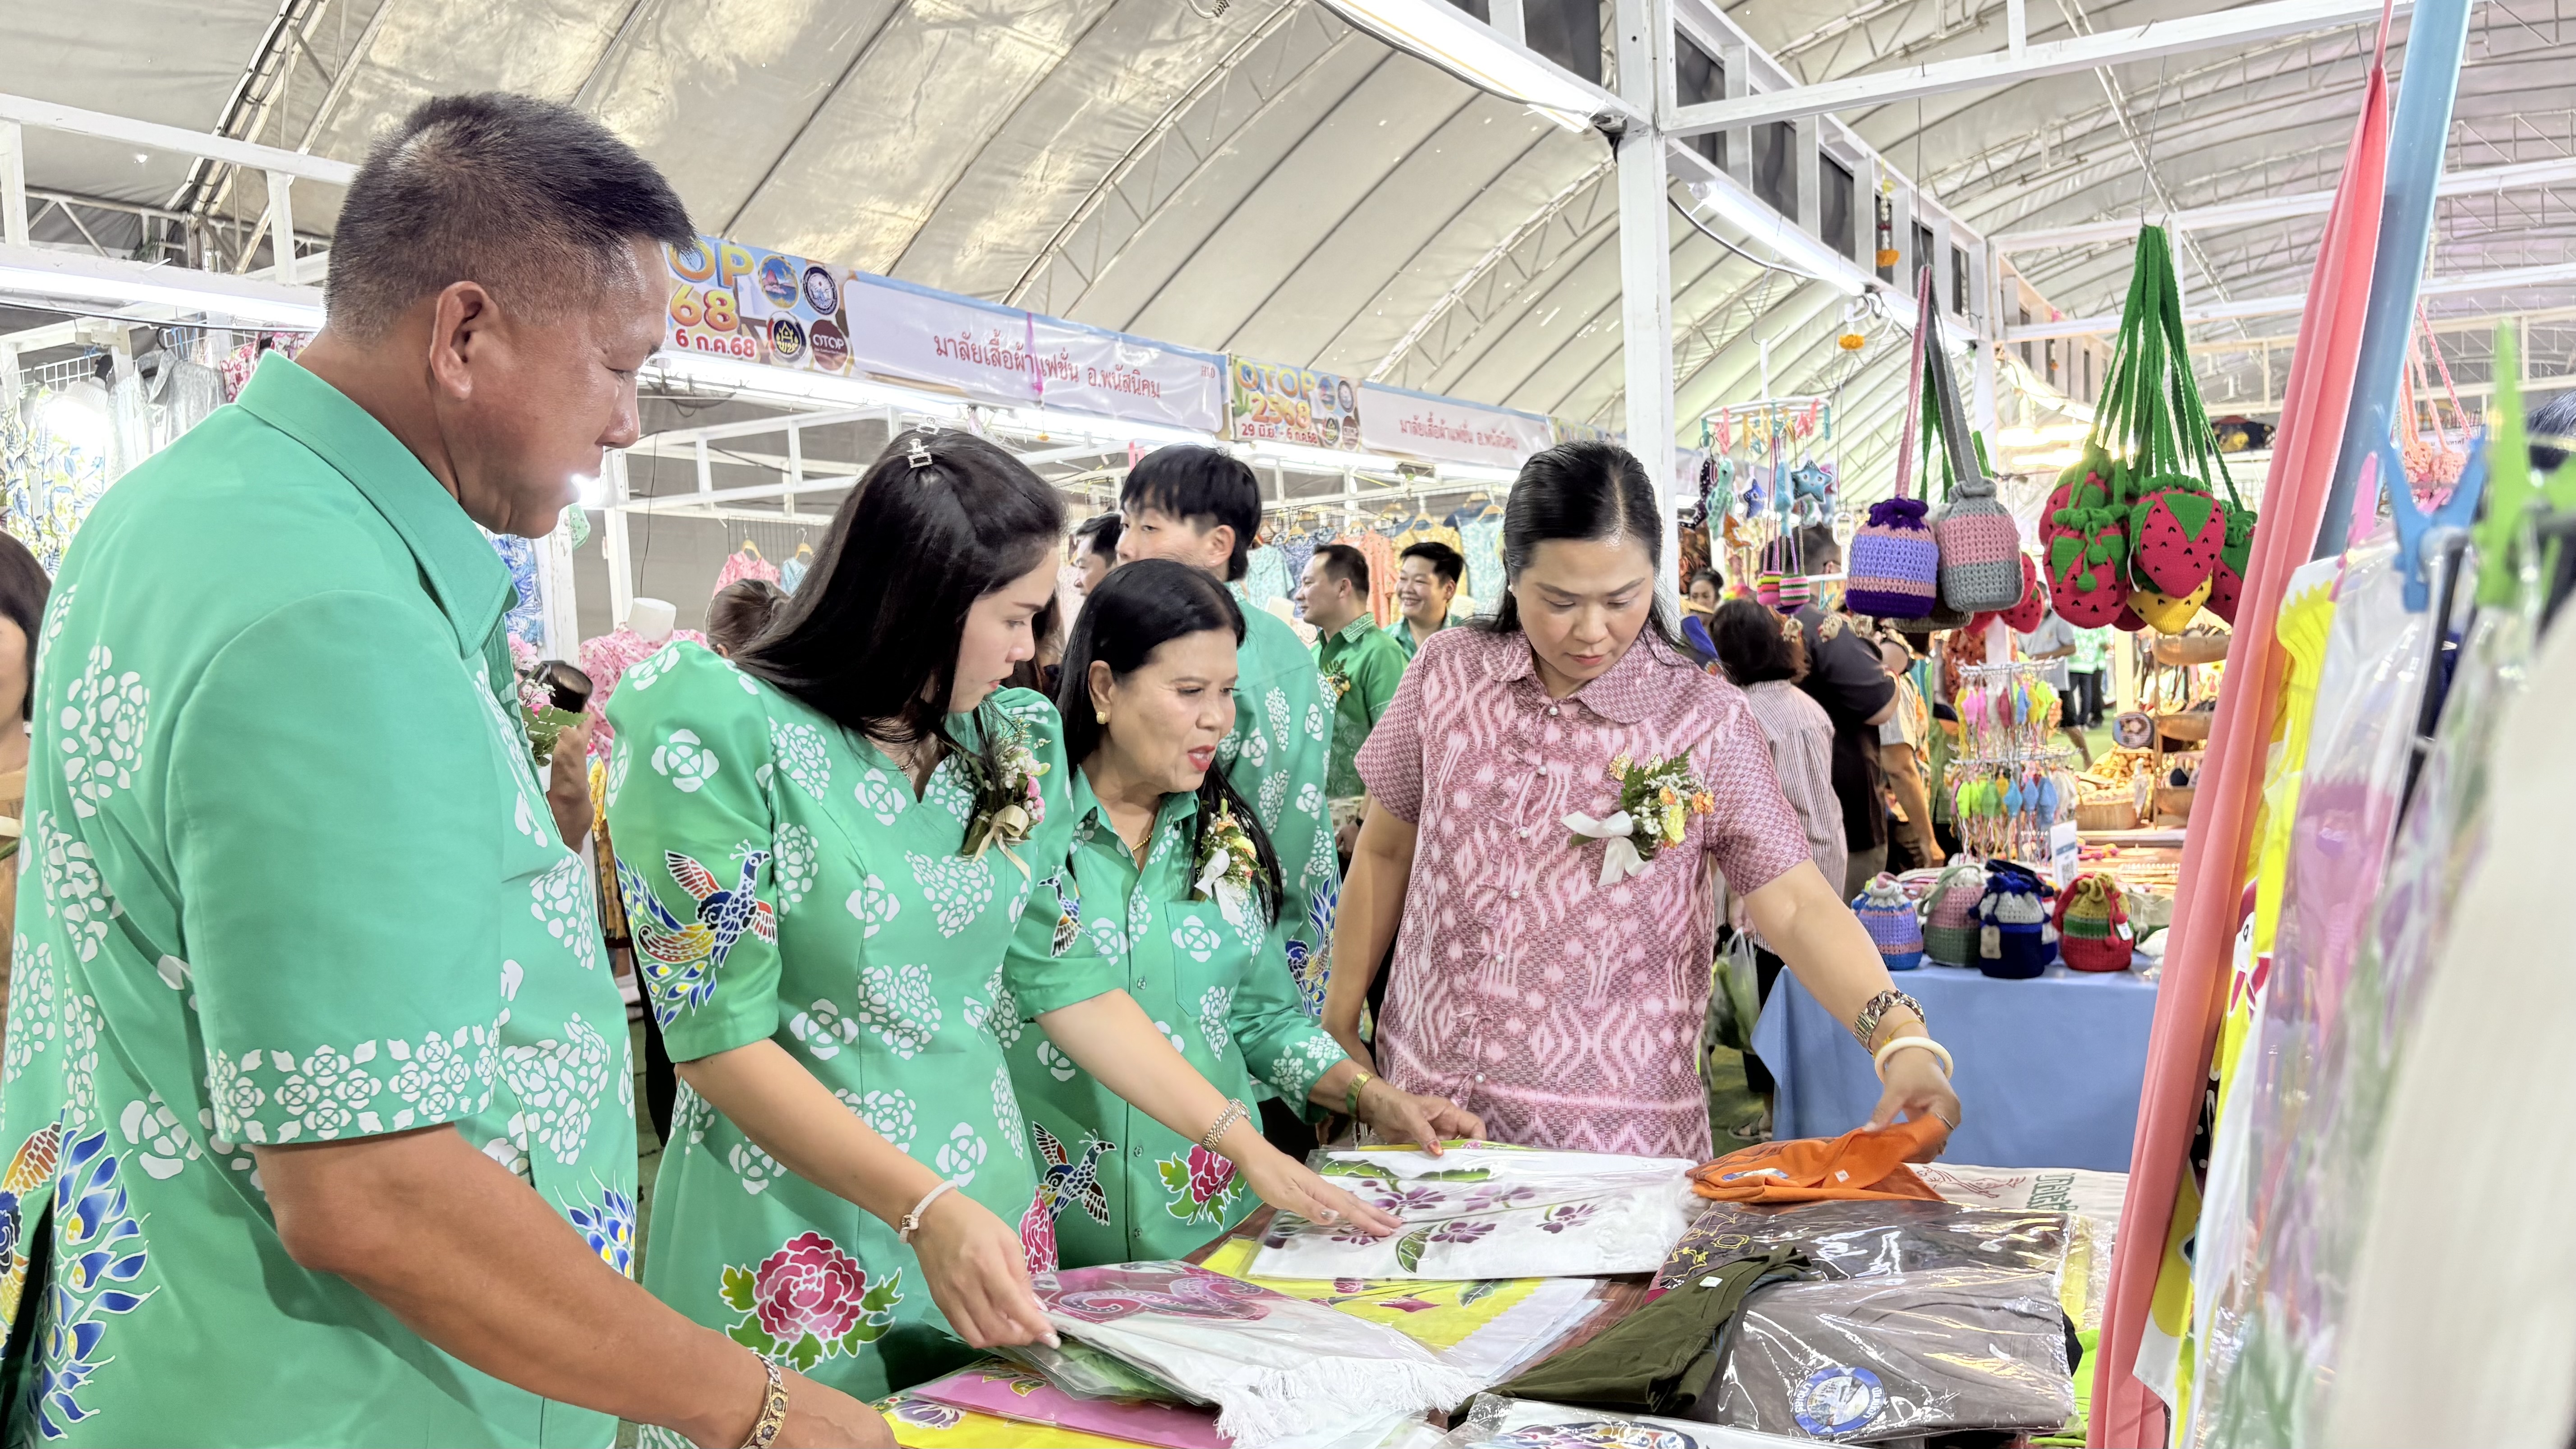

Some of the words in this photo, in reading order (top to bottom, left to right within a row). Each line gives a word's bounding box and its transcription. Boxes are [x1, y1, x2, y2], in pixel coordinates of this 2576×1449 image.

[668, 239, 754, 289] OP
[670, 285, 738, 331] 68
[676, 329, 689, 348] 6
[696, 336, 755, 358] ก.ค.68
[813, 334, 844, 350] OTOP
[1087, 364, 1161, 398] อ.พนัสนิคม
[1236, 359, 1316, 400] OTOP
[1251, 393, 1312, 429] 2568
[1242, 423, 1255, 436] 29
[1287, 428, 1293, 440] 6
